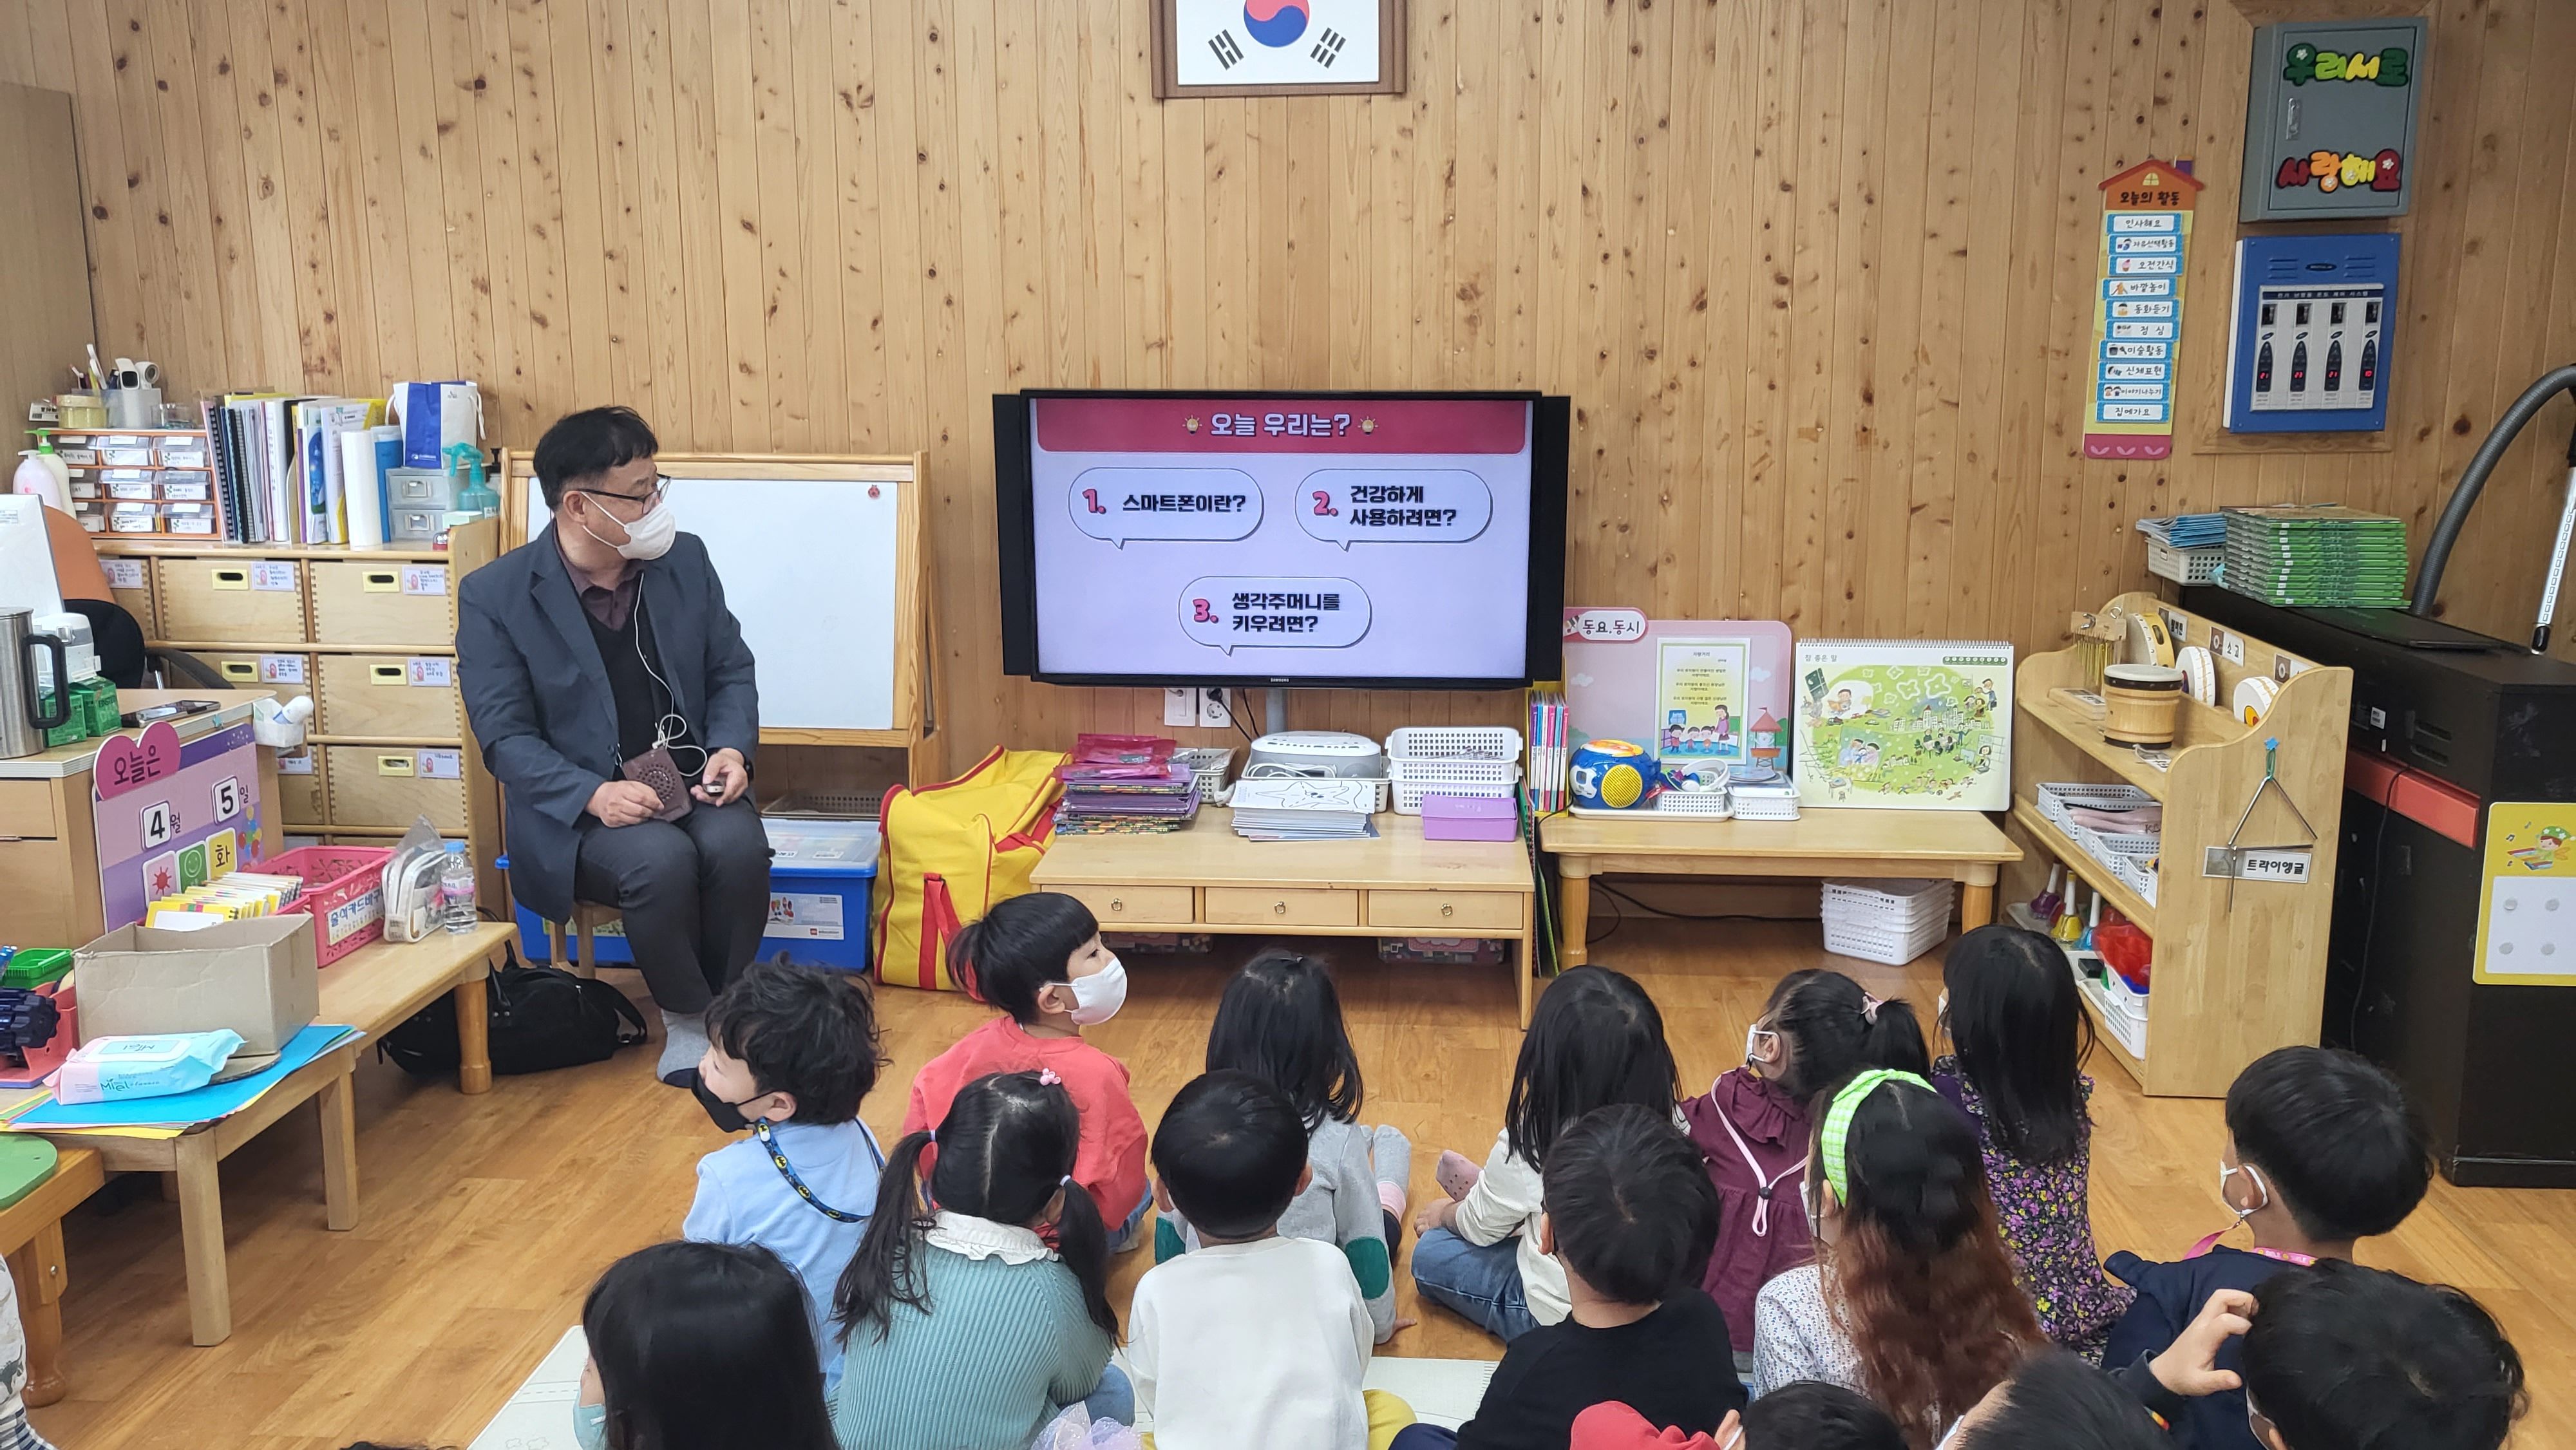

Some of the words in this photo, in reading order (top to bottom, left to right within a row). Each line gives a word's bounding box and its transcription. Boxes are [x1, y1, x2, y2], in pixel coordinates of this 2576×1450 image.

[2283, 43, 2409, 87] 우리서로
[2275, 149, 2401, 193] 사랑해요
[2120, 192, 2153, 206] 오늘의
[2158, 191, 2180, 206] 활동
[2125, 219, 2162, 229] 인사해요
[2133, 238, 2174, 248] 자유선택활동
[2138, 259, 2174, 270] 오전간식
[2130, 282, 2166, 292] 바깥놀이
[2134, 304, 2170, 314] 동화듣기
[2127, 345, 2164, 356] 미술활동
[2126, 367, 2162, 376] 신체표현
[2121, 387, 2161, 395] 이야기나누기
[2115, 408, 2150, 417] 집에가요
[1210, 413, 1256, 437] 오늘
[1264, 413, 1351, 437] 우리는?
[1082, 489, 1106, 514] 1.
[1122, 494, 1246, 513] 스마트폰이란?
[1350, 485, 1424, 504] 건강하게
[1312, 491, 1339, 517] 2.
[1350, 509, 1457, 527] 사용하려면?
[1232, 592, 1340, 610] 생각주머니를
[1193, 598, 1219, 624] 3.
[1233, 615, 1318, 633] 키우려면?
[114, 745, 161, 786] 오늘은
[220, 785, 234, 814] 5
[240, 784, 249, 804] 일
[150, 810, 166, 839] 4
[170, 812, 181, 834] 월
[215, 844, 231, 868] 화
[2246, 859, 2304, 874] 트라이앵글
[100, 1078, 129, 1093] Miel
